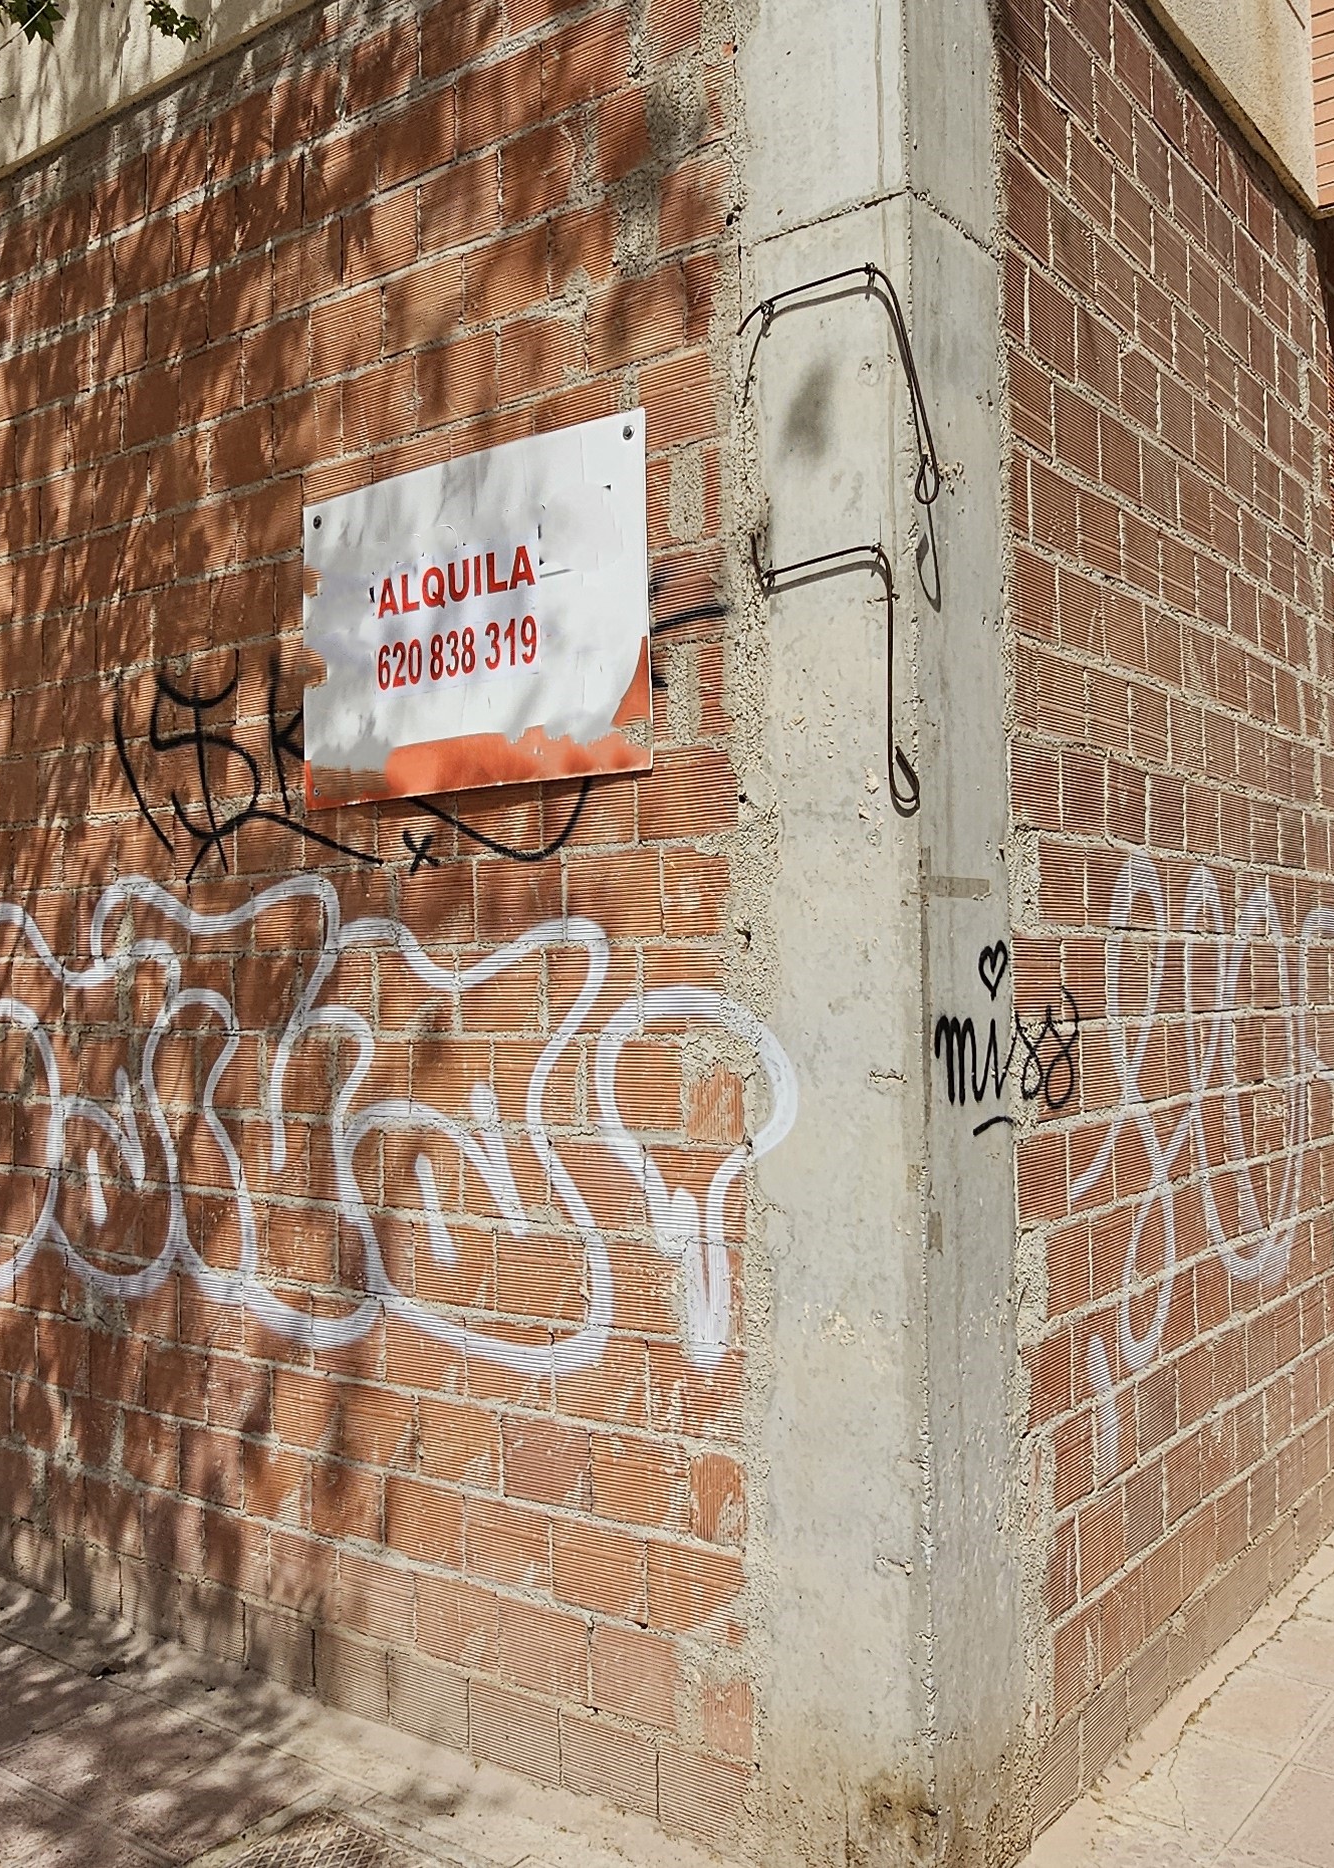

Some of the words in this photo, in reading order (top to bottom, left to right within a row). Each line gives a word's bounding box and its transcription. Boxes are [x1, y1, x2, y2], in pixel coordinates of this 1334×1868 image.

[378, 545, 536, 619] ALQUILA
[378, 638, 423, 691] 620
[430, 626, 476, 681] 838
[485, 615, 537, 670] 319
